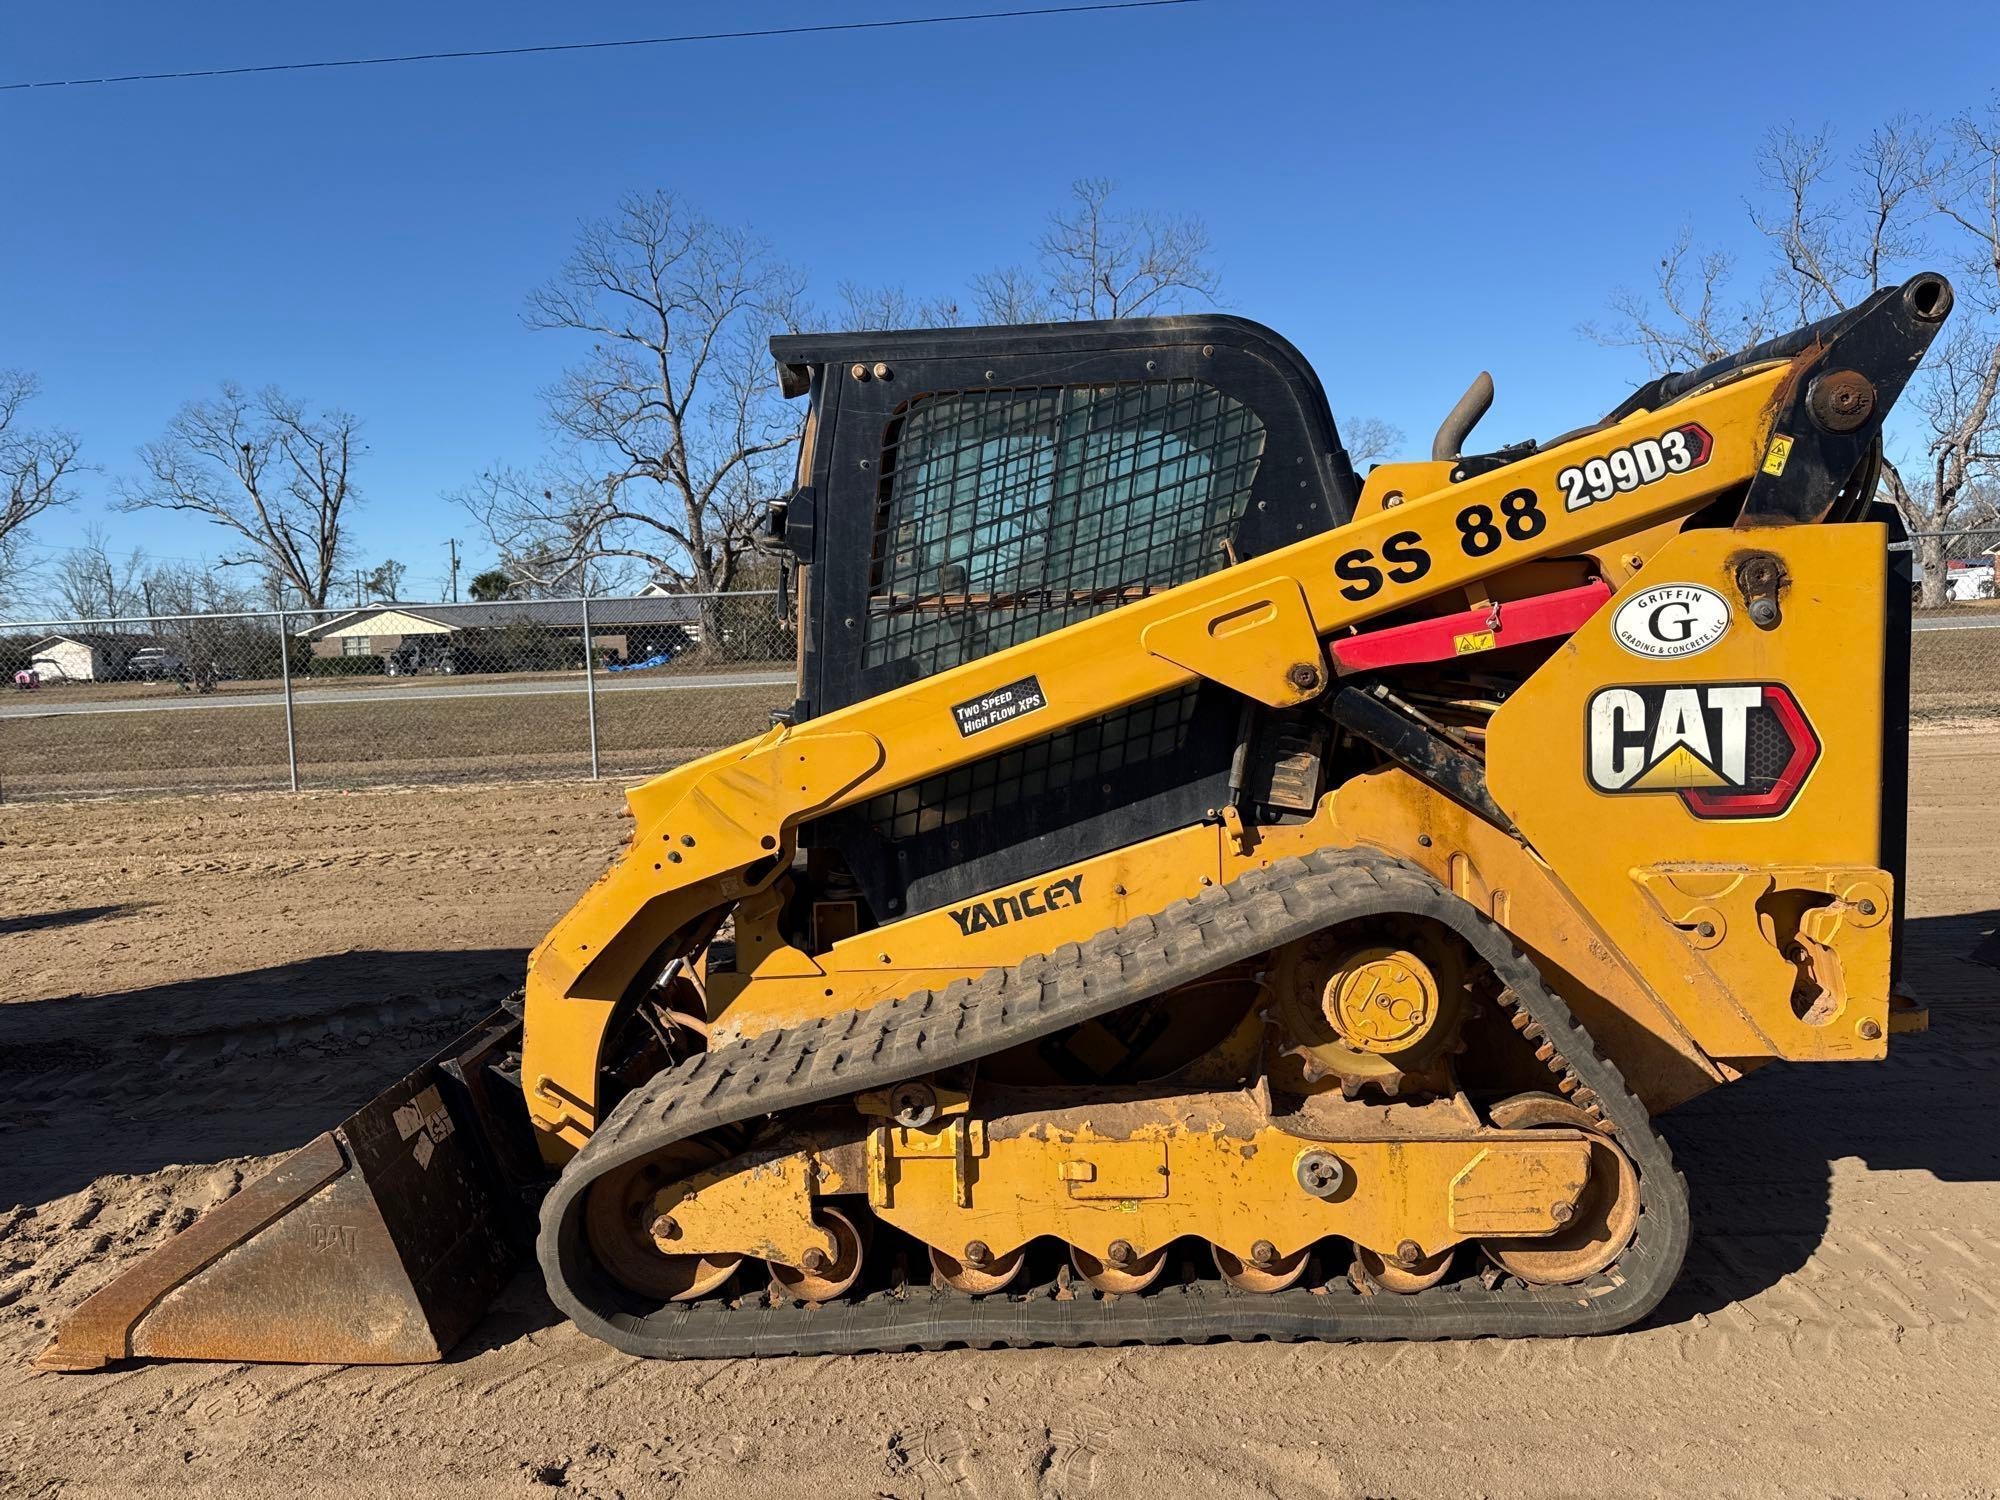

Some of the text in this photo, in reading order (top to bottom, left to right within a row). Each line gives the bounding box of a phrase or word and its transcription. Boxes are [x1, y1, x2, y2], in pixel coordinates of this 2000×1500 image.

[1559, 431, 1691, 511] 299D3
[1334, 488, 1546, 601] SS 88
[1638, 589, 1702, 609] GRIFFIN
[1621, 630, 1655, 653] GRADING
[1658, 646, 1664, 654] &
[1712, 619, 1725, 634] LLC
[1648, 601, 1698, 642] G
[1018, 694, 1040, 712] XPS
[1591, 686, 1762, 789] CAT
[947, 873, 1083, 936] YANCEY
[308, 1223, 358, 1257] CAT
